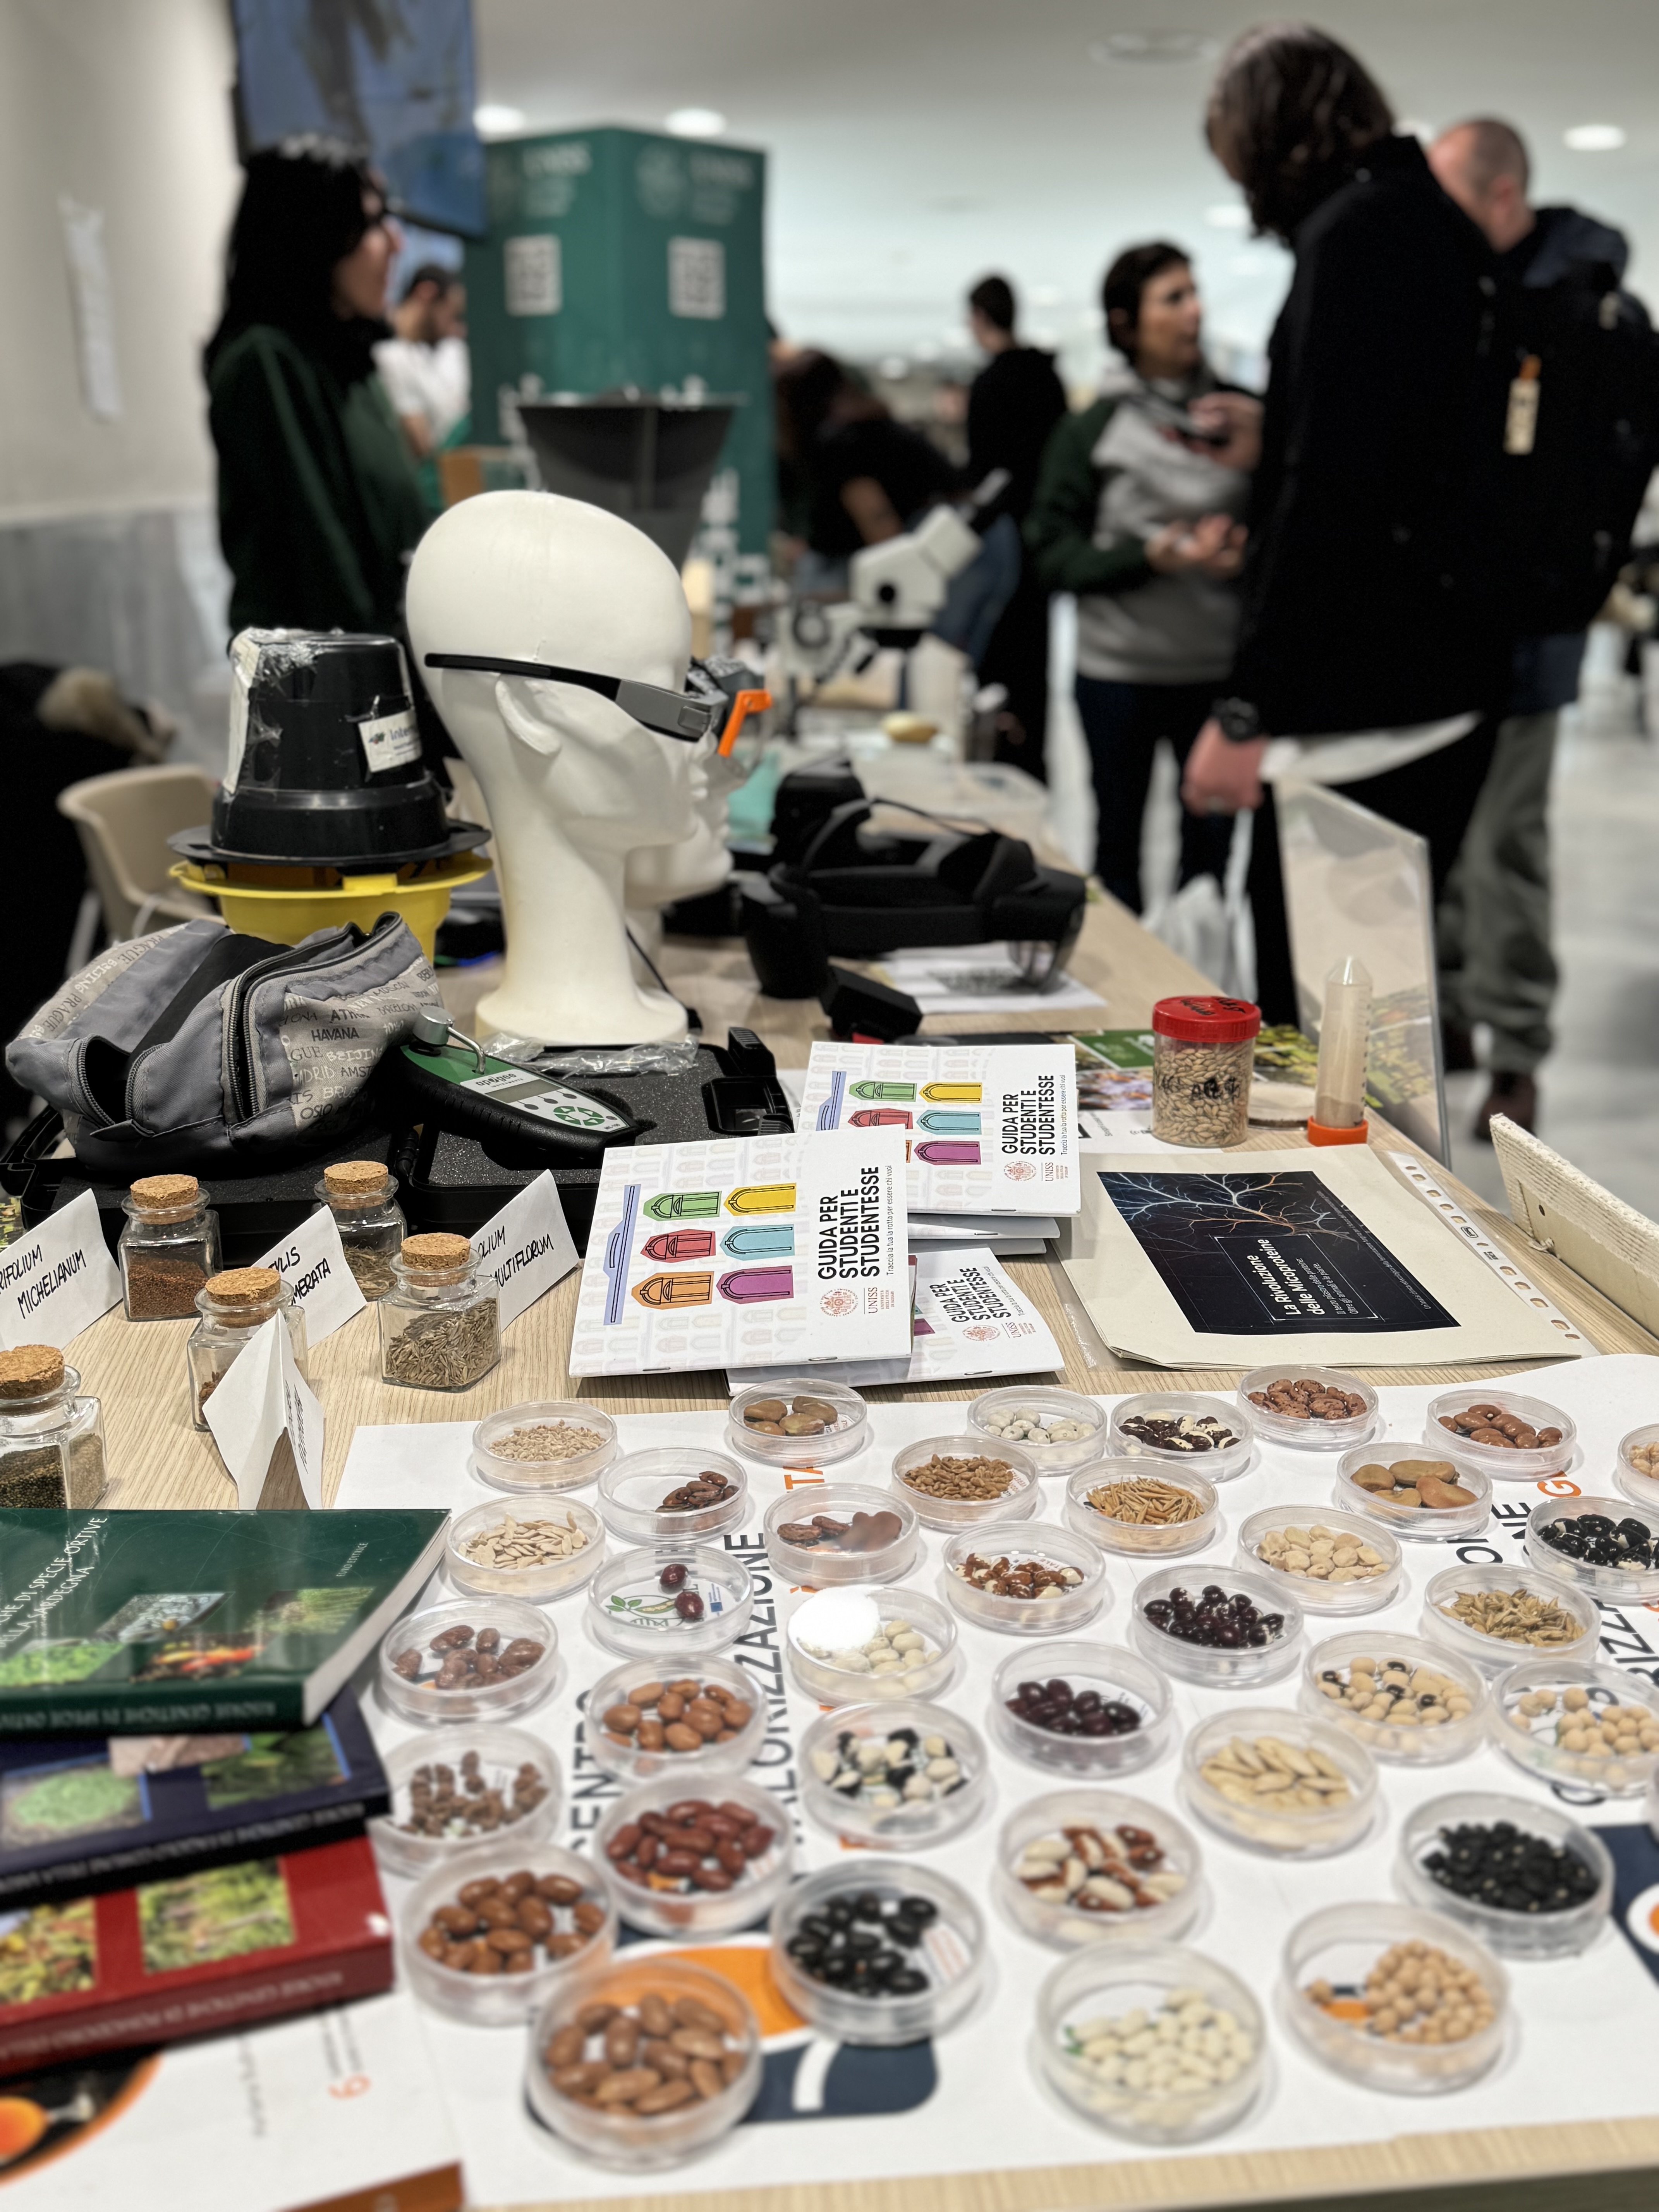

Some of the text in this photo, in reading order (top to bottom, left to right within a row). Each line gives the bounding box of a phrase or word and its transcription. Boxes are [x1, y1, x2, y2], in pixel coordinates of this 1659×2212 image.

[43, 993, 81, 1032] PRAGUE
[311, 1027, 359, 1042] HAVANA
[290, 1046, 323, 1061] GUE
[1002, 1094, 1018, 1154] GUIDA PER
[1020, 1099, 1037, 1155] STUDENTI
[1038, 1075, 1055, 1155] STUDENTESSE
[1045, 1162, 1054, 1182] UNISS
[839, 1189, 859, 1278] STUDENTI E
[860, 1167, 880, 1277] STUDENTESSE
[886, 1206, 894, 1215] per
[478, 1225, 505, 1260] OLIUM
[818, 1195, 838, 1279] GUIDA PER
[0, 1244, 42, 1294] RIFOLIUM
[17, 1249, 86, 1319] MICHELIANUM
[291, 1258, 331, 1306] MERATA
[959, 1267, 1012, 1318] STUDENTESSE
[1247, 1255, 1302, 1315] La Rivoluzione
[1257, 1239, 1326, 1315] delle Micoproteine
[868, 1287, 878, 1314] UNISS
[929, 1283, 970, 1322] GUIDA PER
[951, 1285, 991, 1320] STUDENTI
[14, 1592, 38, 1601] DI
[29, 1557, 73, 1589] SPECIE
[64, 1517, 108, 1554] ORTIVE
[336, 1542, 369, 1577] EURO EDITRICE
[27, 1566, 95, 1618] SARDEGNA
